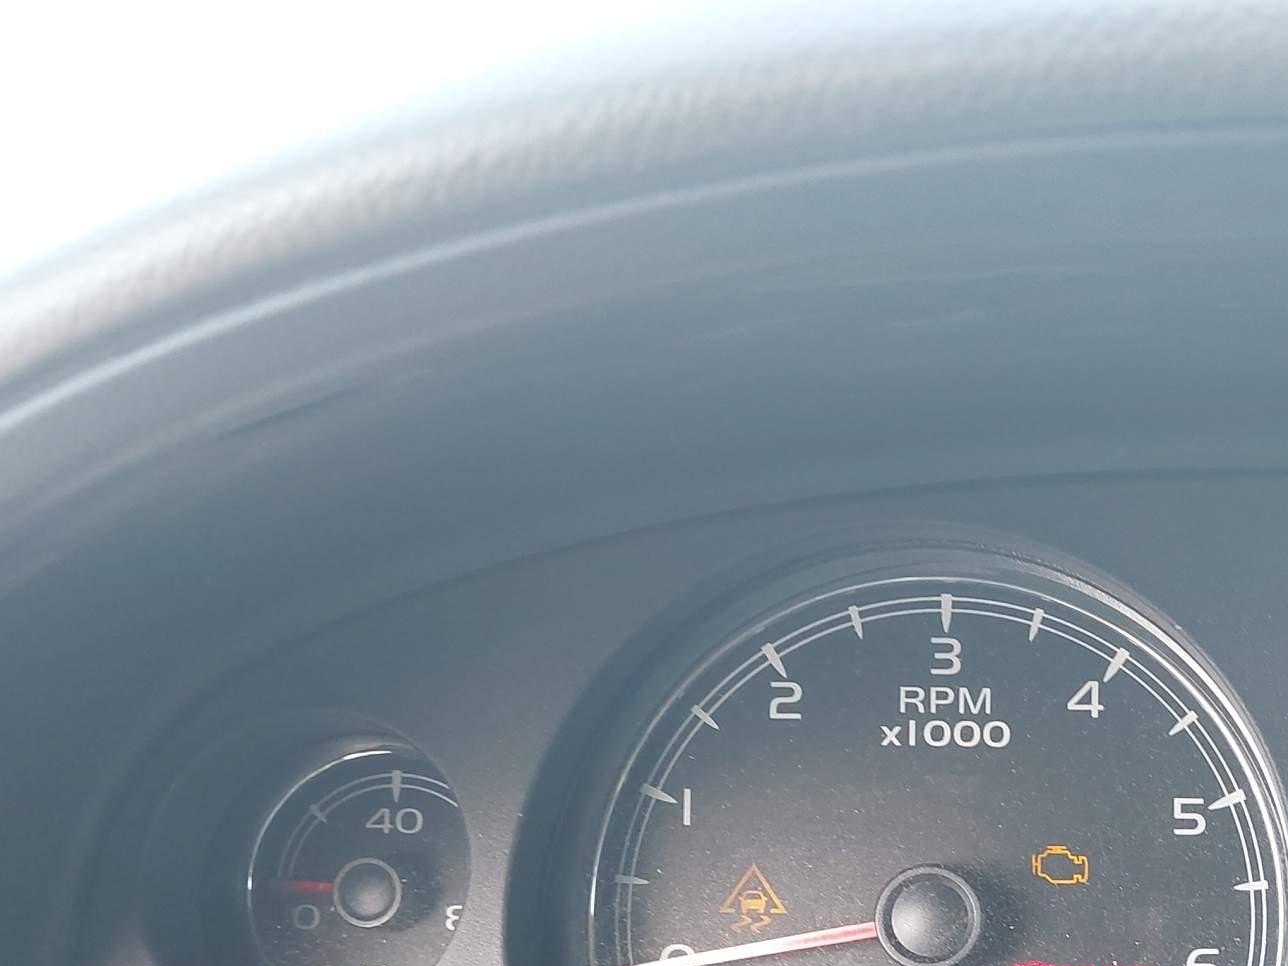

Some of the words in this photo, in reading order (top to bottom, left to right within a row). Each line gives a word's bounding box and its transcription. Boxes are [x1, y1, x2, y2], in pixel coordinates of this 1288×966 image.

[931, 637, 964, 676] 3
[769, 682, 802, 720] 2
[900, 687, 992, 715] RPM
[1067, 680, 1105, 718] 4
[880, 721, 1011, 749] x1000
[365, 808, 423, 834] 40
[682, 788, 692, 826] 1
[1173, 798, 1207, 836] 5
[293, 904, 320, 930] 0
